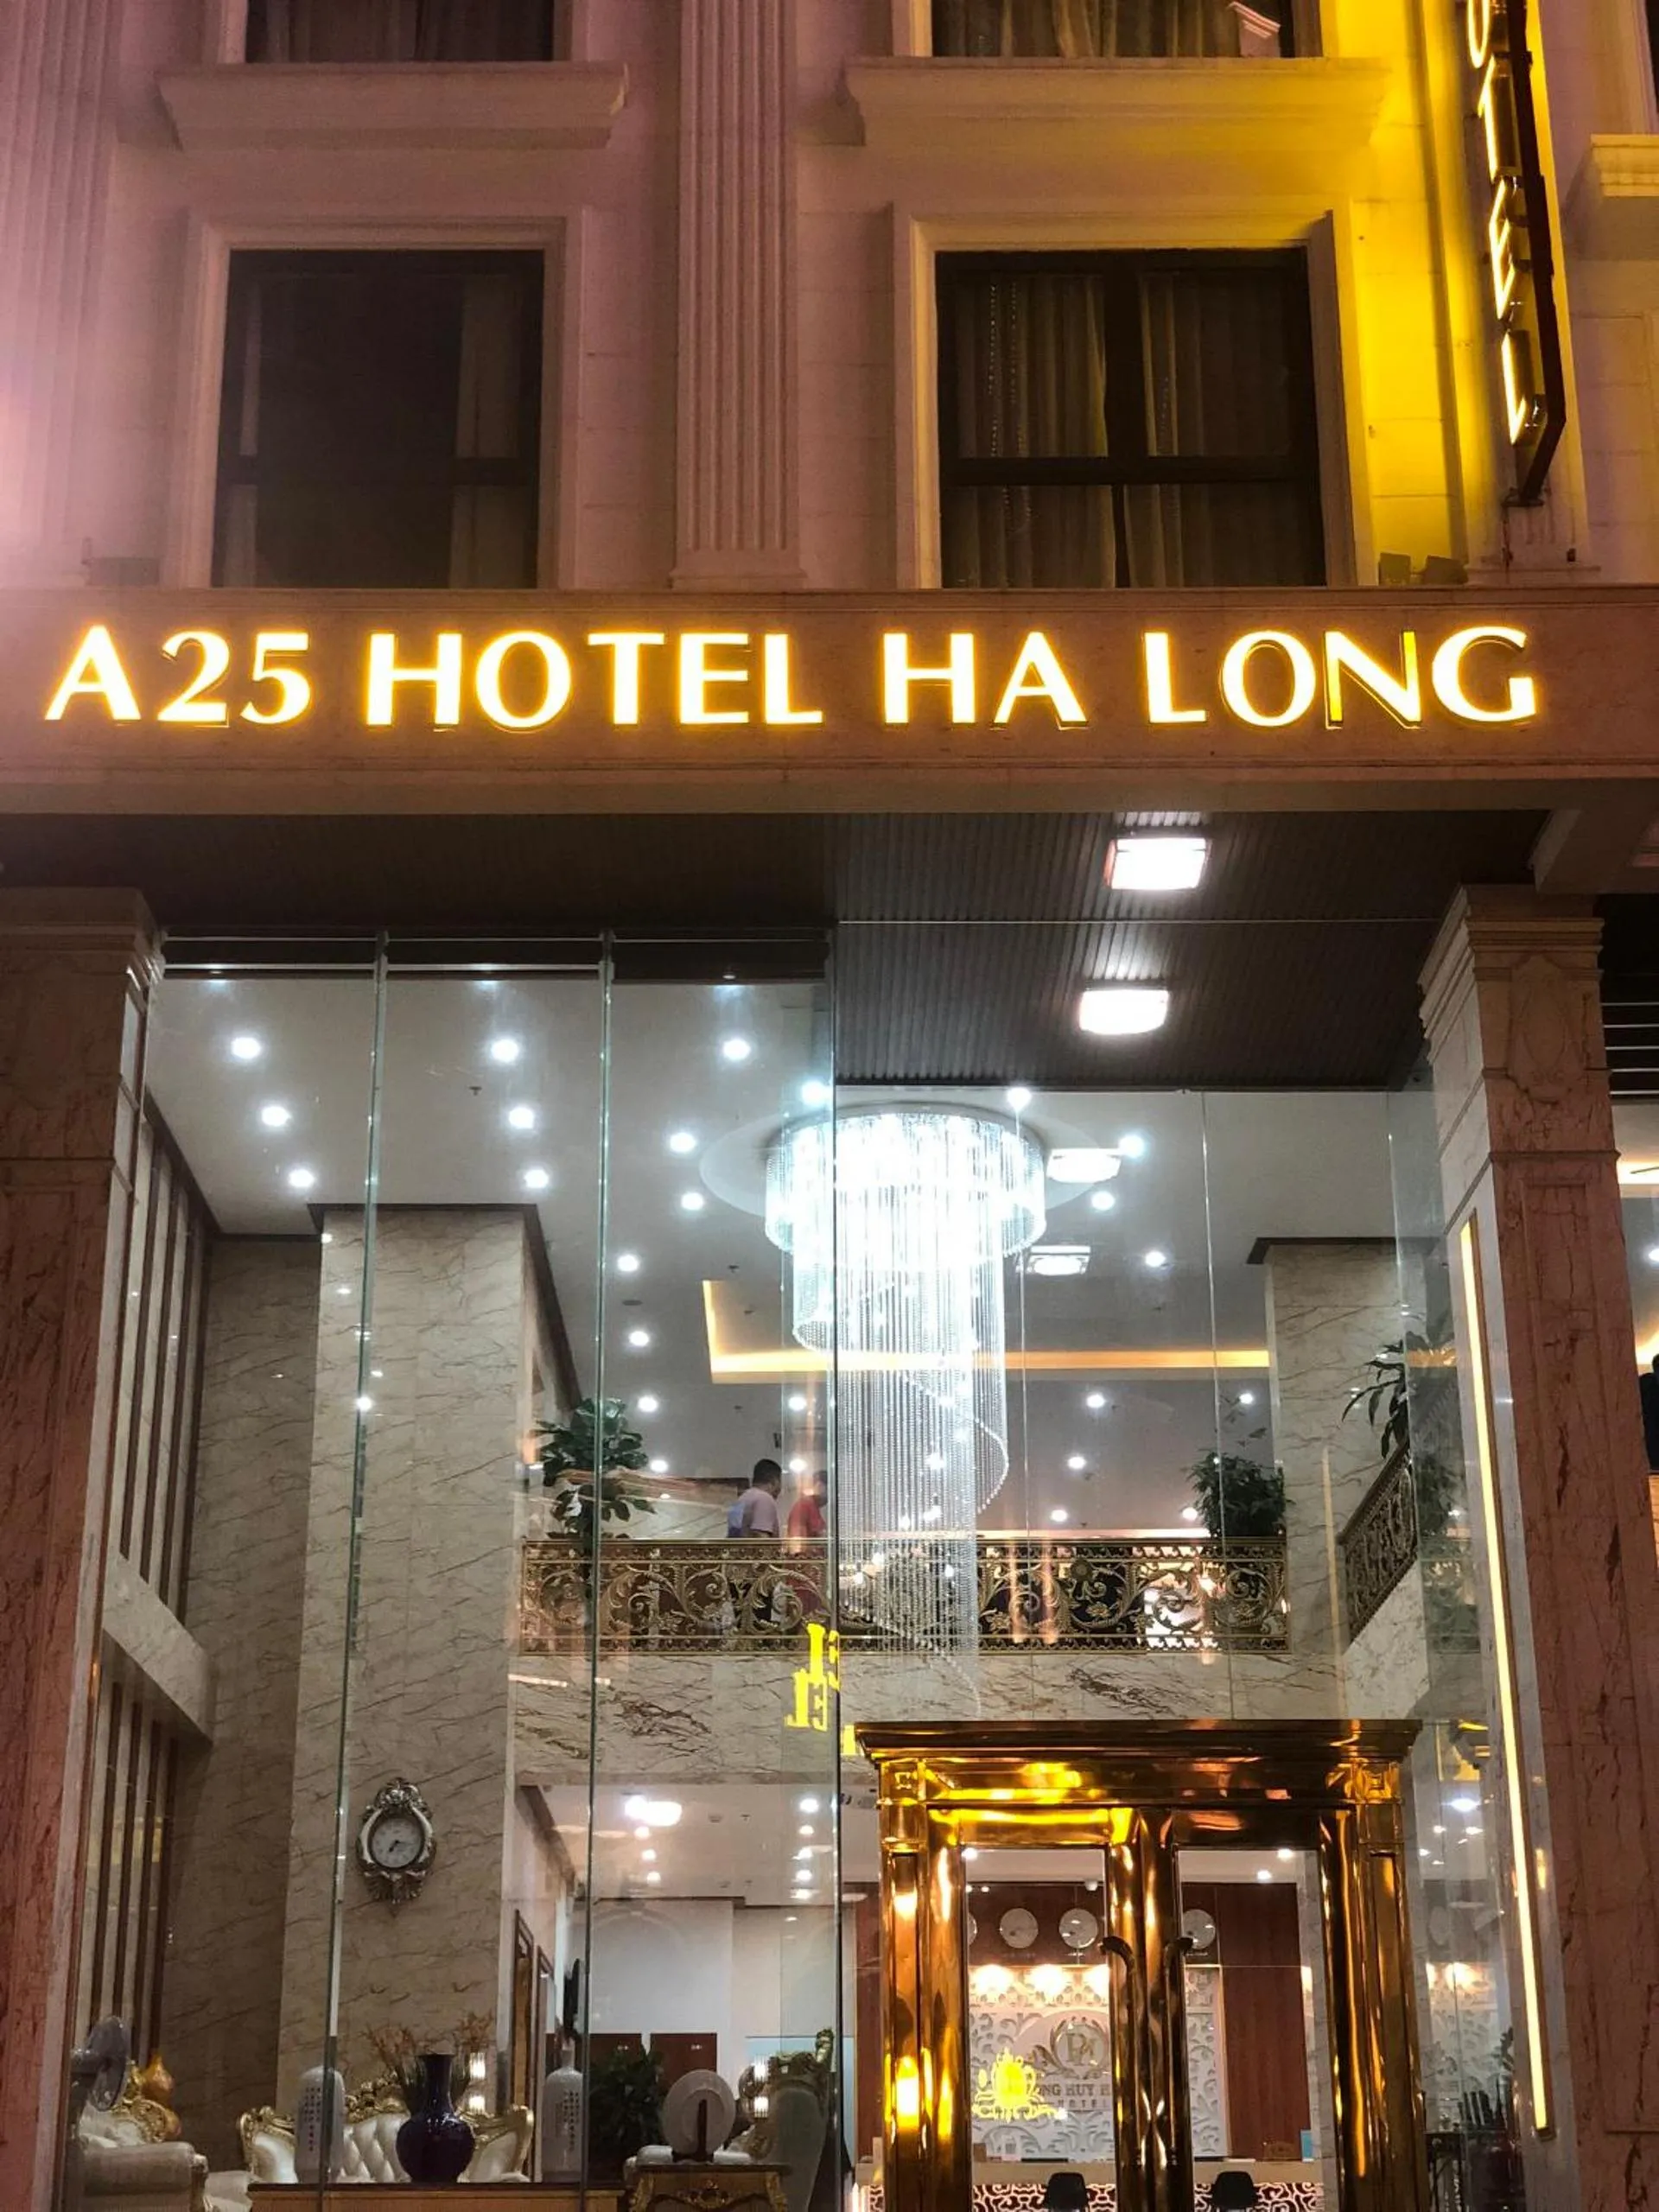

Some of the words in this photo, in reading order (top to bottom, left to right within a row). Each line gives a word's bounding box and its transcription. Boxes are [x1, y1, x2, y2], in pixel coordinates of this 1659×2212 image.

[45, 625, 312, 728] A25
[366, 630, 823, 730] HOTEL
[882, 631, 1090, 728] HA
[1143, 626, 1536, 728] LONG
[1065, 2083, 1094, 2096] HUY
